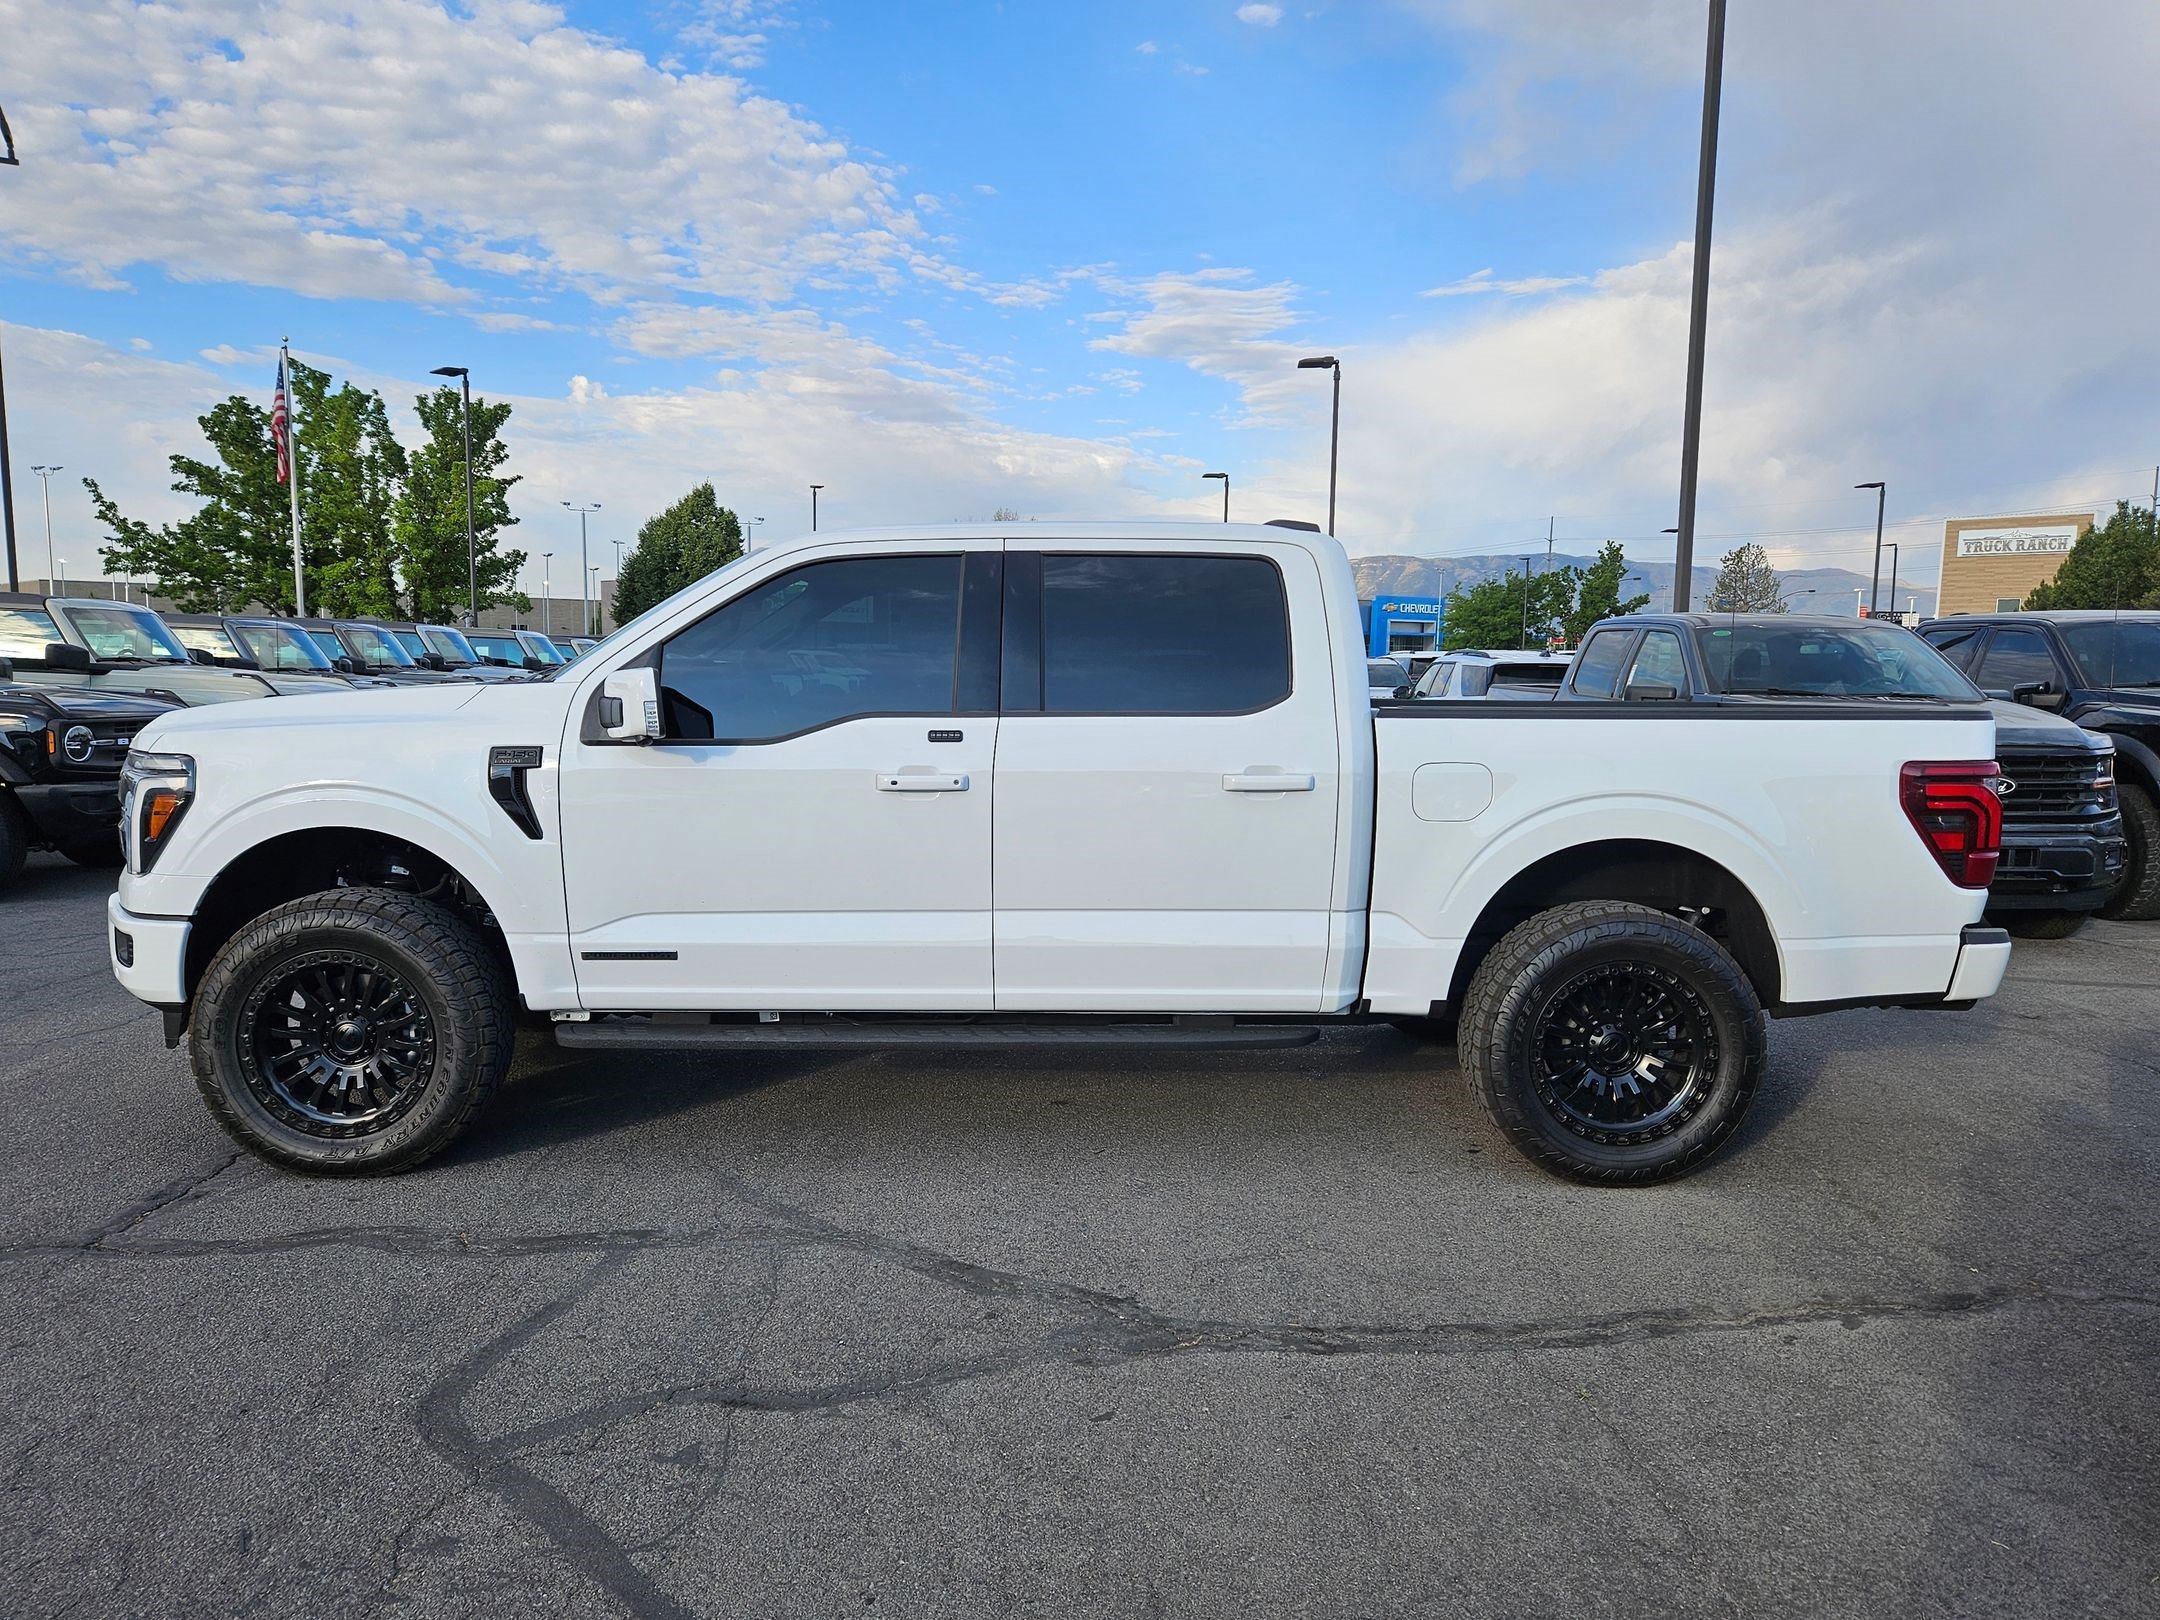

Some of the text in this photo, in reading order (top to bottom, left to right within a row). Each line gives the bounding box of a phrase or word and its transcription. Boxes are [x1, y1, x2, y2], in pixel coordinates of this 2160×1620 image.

[1964, 537, 2068, 553] TRUCK RANCH
[1400, 604, 1442, 614] CHEVROLET
[381, 1067, 451, 1151] COUNTRY
[321, 1143, 374, 1160] A/T
